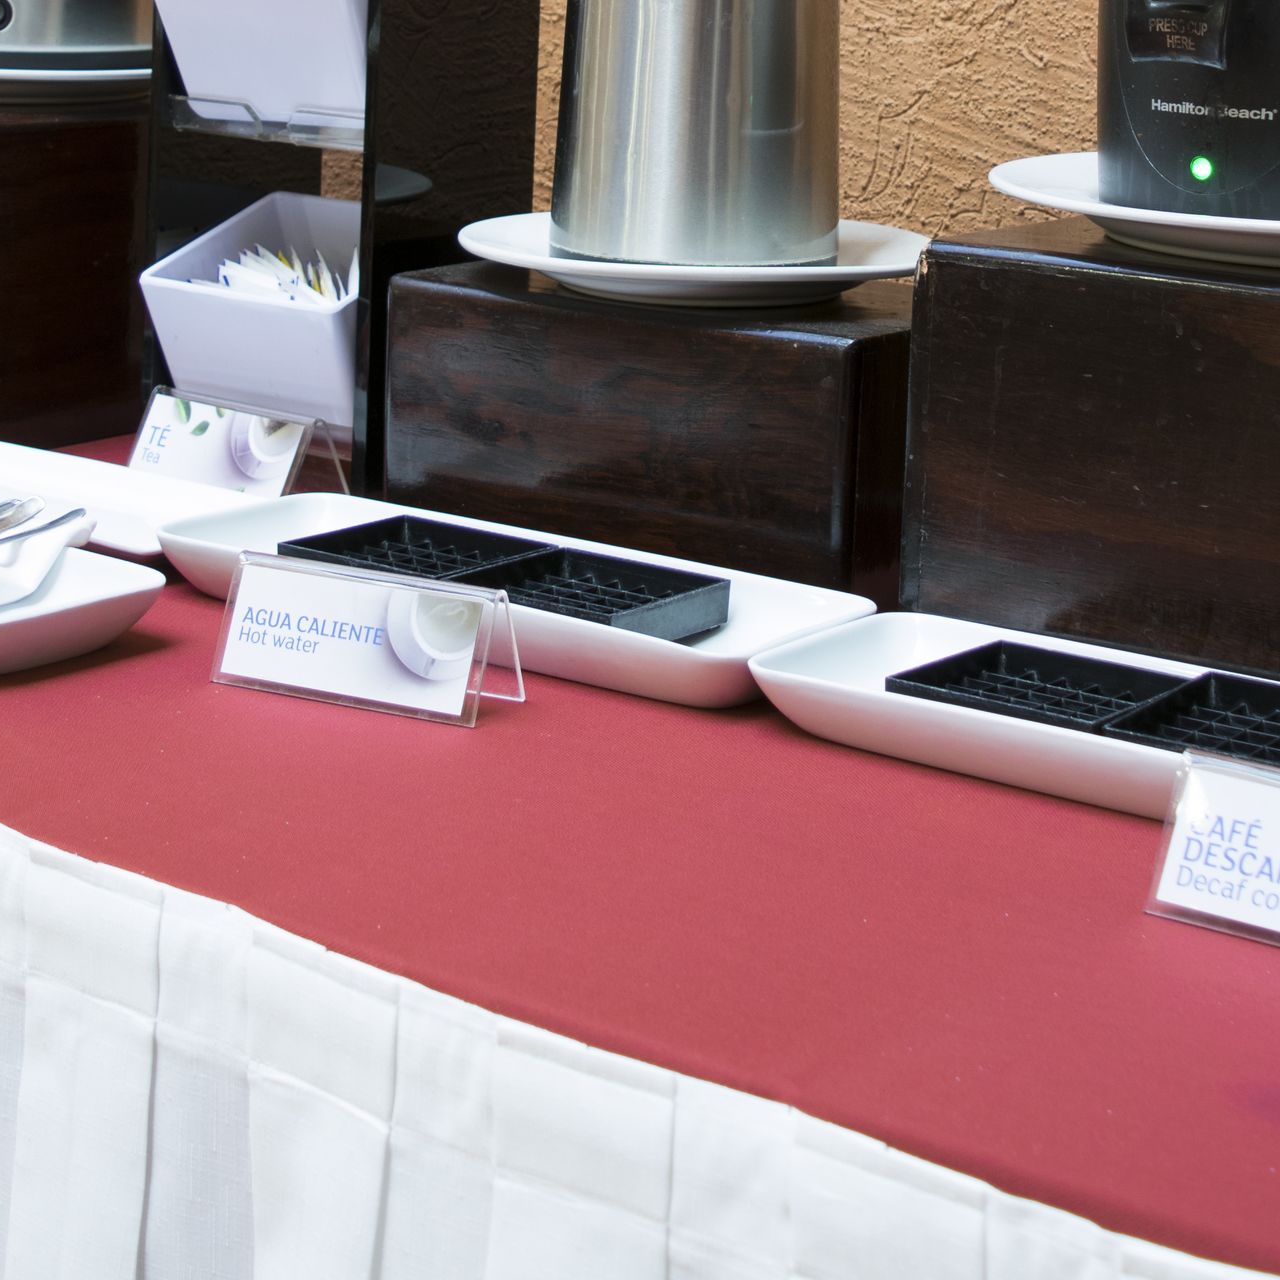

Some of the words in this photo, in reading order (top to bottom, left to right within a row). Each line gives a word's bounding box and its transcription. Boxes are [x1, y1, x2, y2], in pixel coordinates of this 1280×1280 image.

[1166, 34, 1196, 51] HERE
[150, 424, 172, 449] TÉ
[141, 448, 161, 465] Tea
[242, 606, 292, 631] AGUA
[296, 615, 385, 647] CALIENTE
[238, 626, 268, 647] Hot
[272, 633, 320, 655] water
[1176, 864, 1246, 902] Decaf
